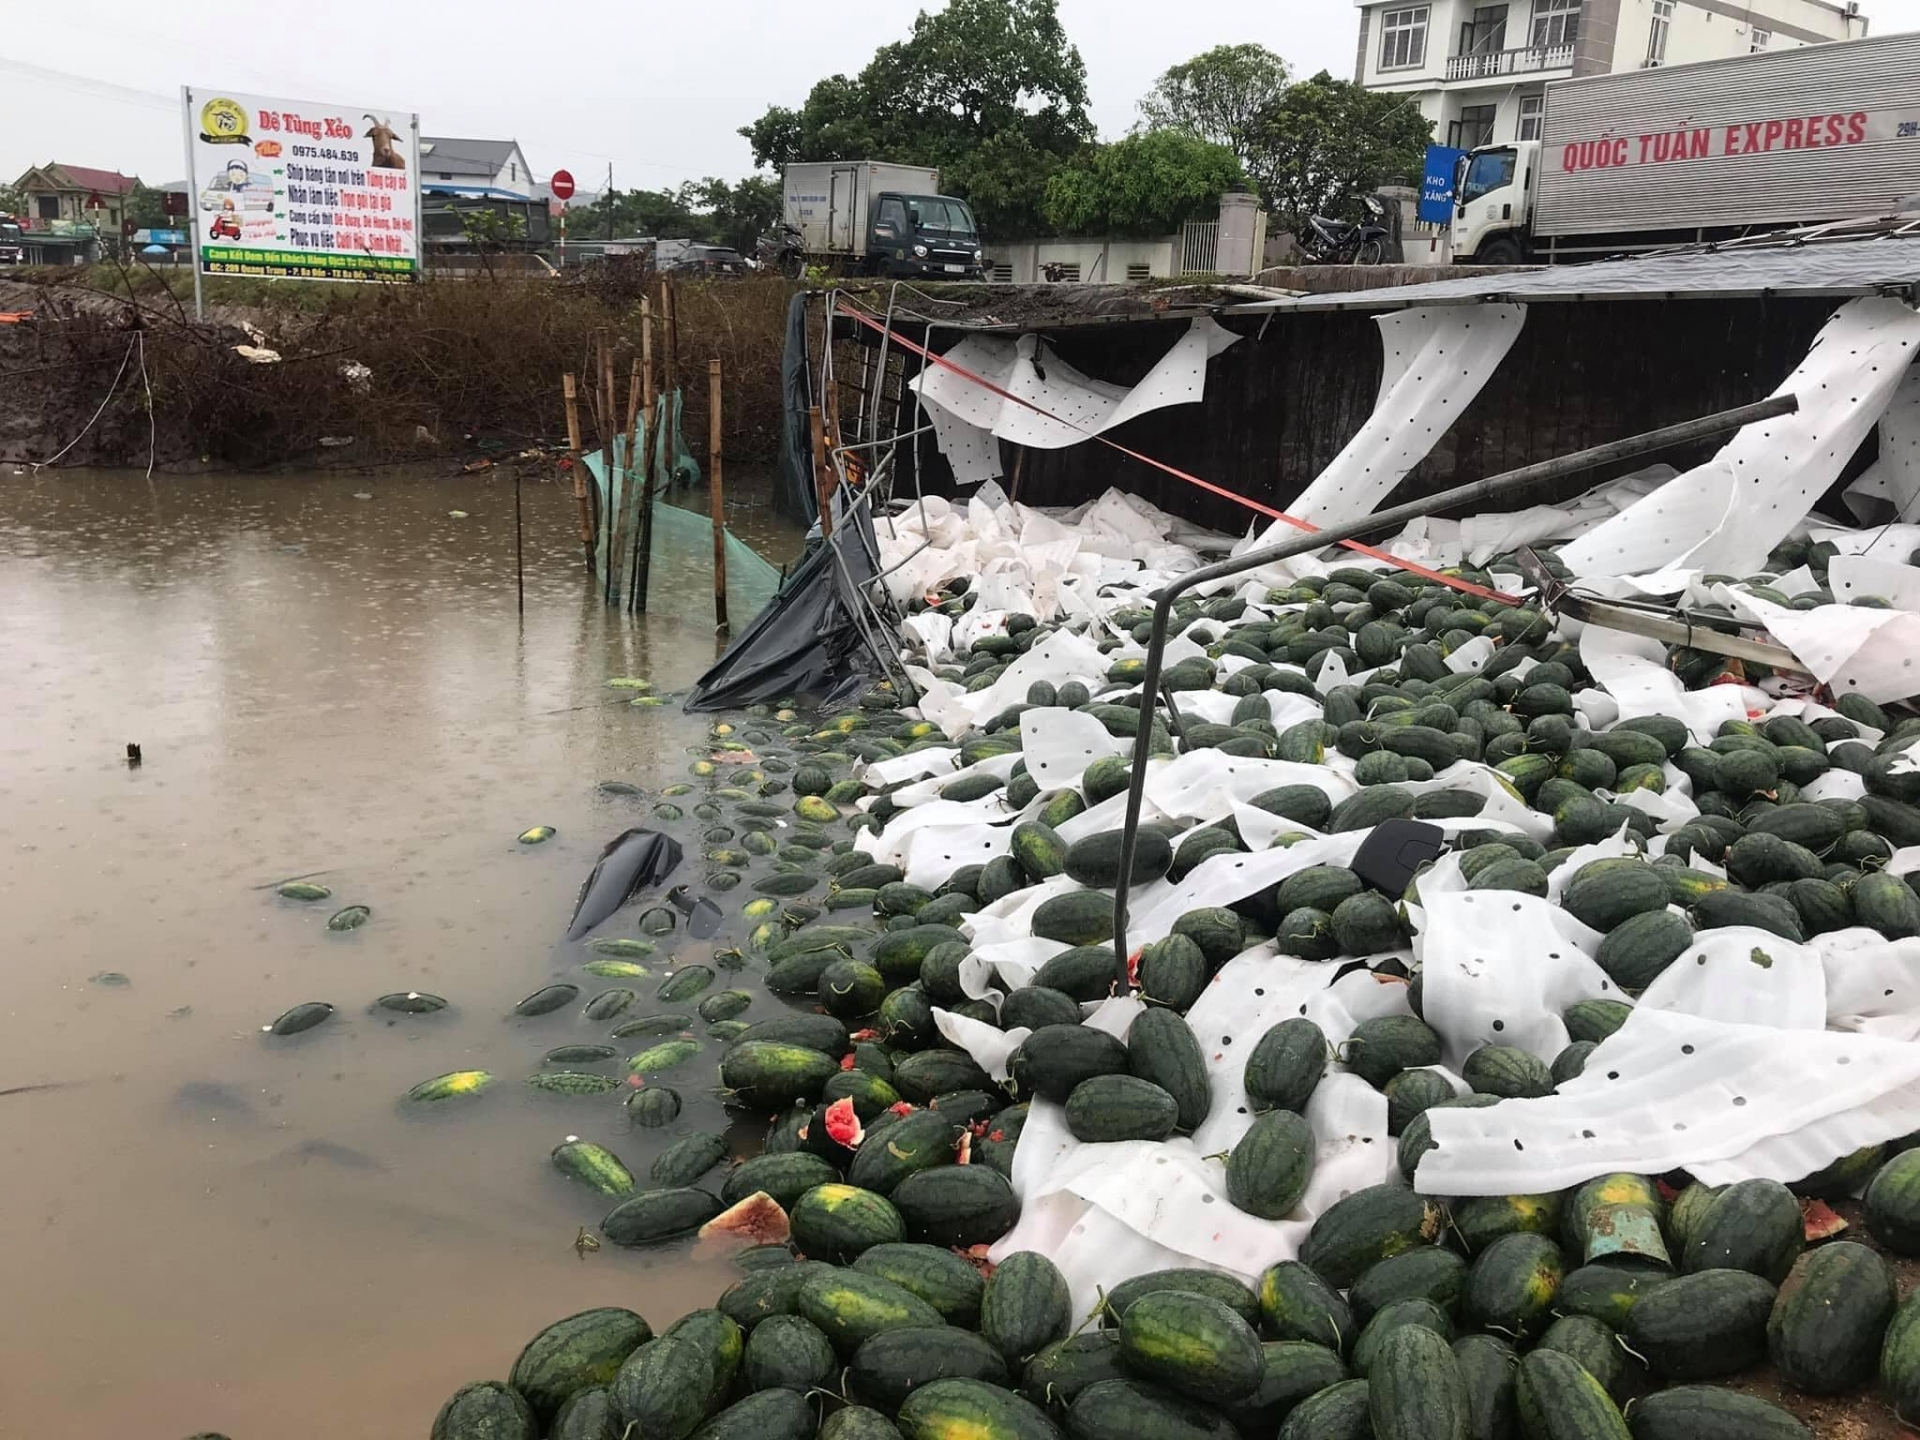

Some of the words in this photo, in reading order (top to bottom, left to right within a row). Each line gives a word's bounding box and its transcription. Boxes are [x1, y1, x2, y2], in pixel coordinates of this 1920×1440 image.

[258, 110, 280, 132] Dê
[282, 114, 322, 140] Tùng
[324, 117, 353, 140] Xẻo
[292, 145, 358, 162] 0975.484.639
[1562, 128, 1628, 174] QUỐC
[1723, 112, 1868, 157] EXPRESS
[287, 164, 304, 182] Ship
[306, 165, 323, 184] hàng
[338, 169, 350, 185] nơi
[351, 169, 365, 186] trên
[366, 170, 383, 190] Từng
[385, 172, 396, 190] cây
[398, 172, 407, 190] số
[1426, 176, 1445, 187] KHO
[288, 185, 307, 207] Nhận
[309, 186, 323, 204] làm
[324, 188, 338, 210] tiệc
[290, 210, 306, 224] Cung
[308, 209, 320, 225] cấp
[322, 212, 333, 228] thịt
[334, 212, 343, 225] Dê
[363, 215, 371, 227] Dê
[290, 228, 308, 250] Phục
[311, 232, 319, 251] vụ
[321, 230, 334, 251] tiệc
[386, 235, 402, 256] Nhật
[209, 249, 228, 259] Cam
[229, 249, 243, 260] Kết
[282, 252, 306, 263] Khách
[266, 266, 287, 275] Trung
